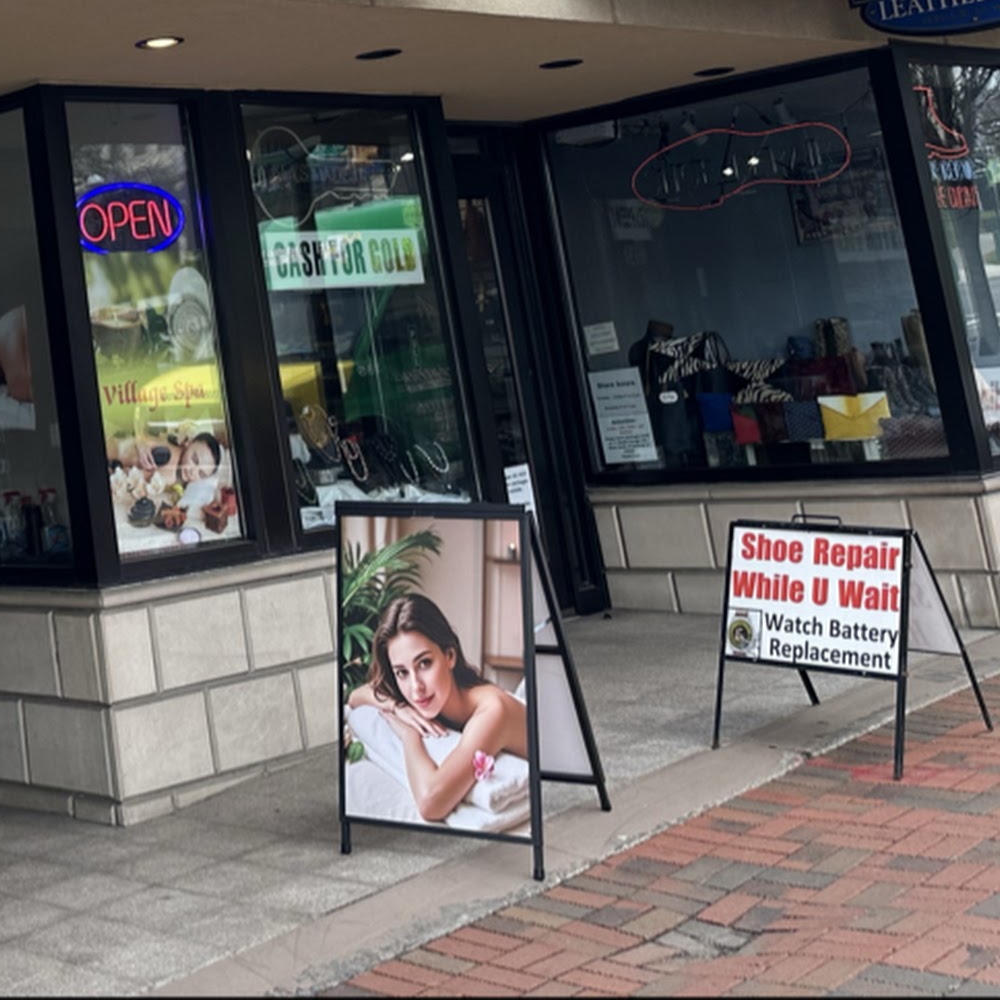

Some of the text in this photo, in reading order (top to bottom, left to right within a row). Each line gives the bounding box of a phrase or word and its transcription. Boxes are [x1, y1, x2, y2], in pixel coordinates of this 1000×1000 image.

[79, 198, 174, 243] OPEN
[273, 237, 417, 279] CASH FOR GOLD
[103, 379, 205, 412] Village Spa
[741, 532, 901, 571] Shoe Repair
[733, 570, 900, 612] While U Wait
[765, 612, 899, 648] Watch Battery
[769, 638, 891, 670] Replacement
